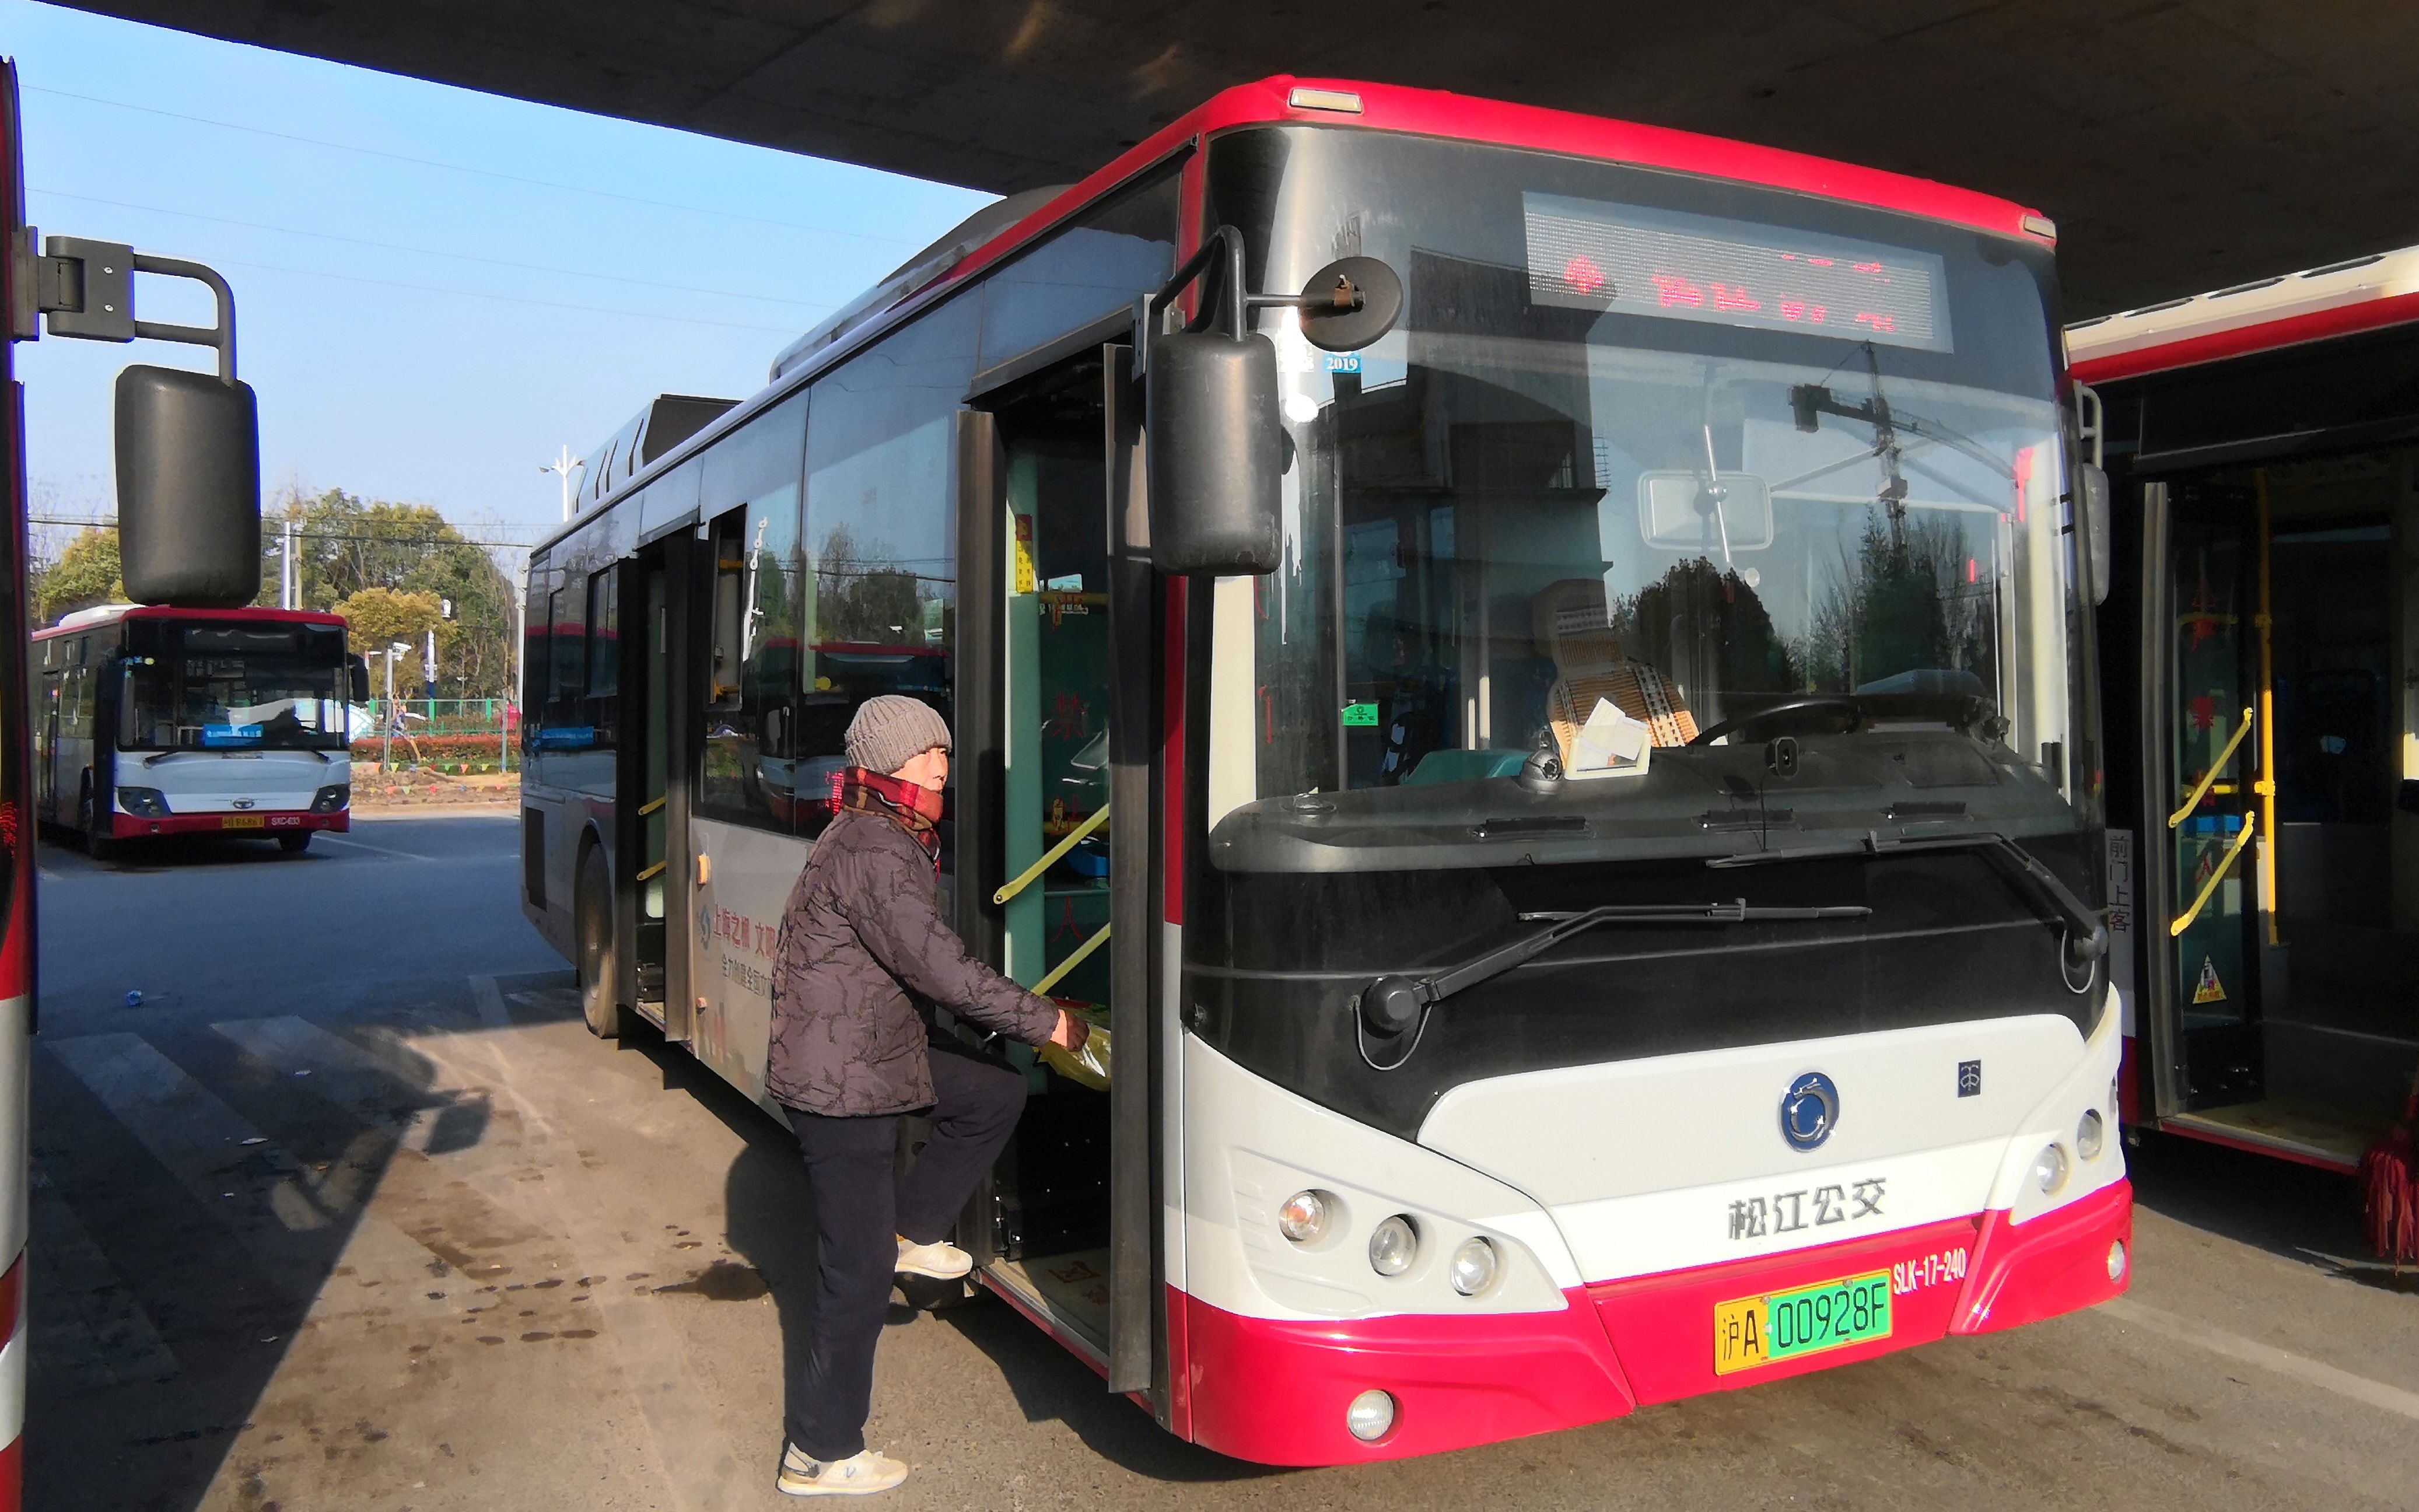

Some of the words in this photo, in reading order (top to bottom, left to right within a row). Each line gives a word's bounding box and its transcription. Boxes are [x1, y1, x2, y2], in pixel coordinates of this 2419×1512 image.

[1325, 357, 1359, 371] 2019
[2109, 835, 2131, 933] 前门上客
[1728, 1177, 1886, 1240] 松江公交
[1893, 1247, 1966, 1295] SLK-17-240
